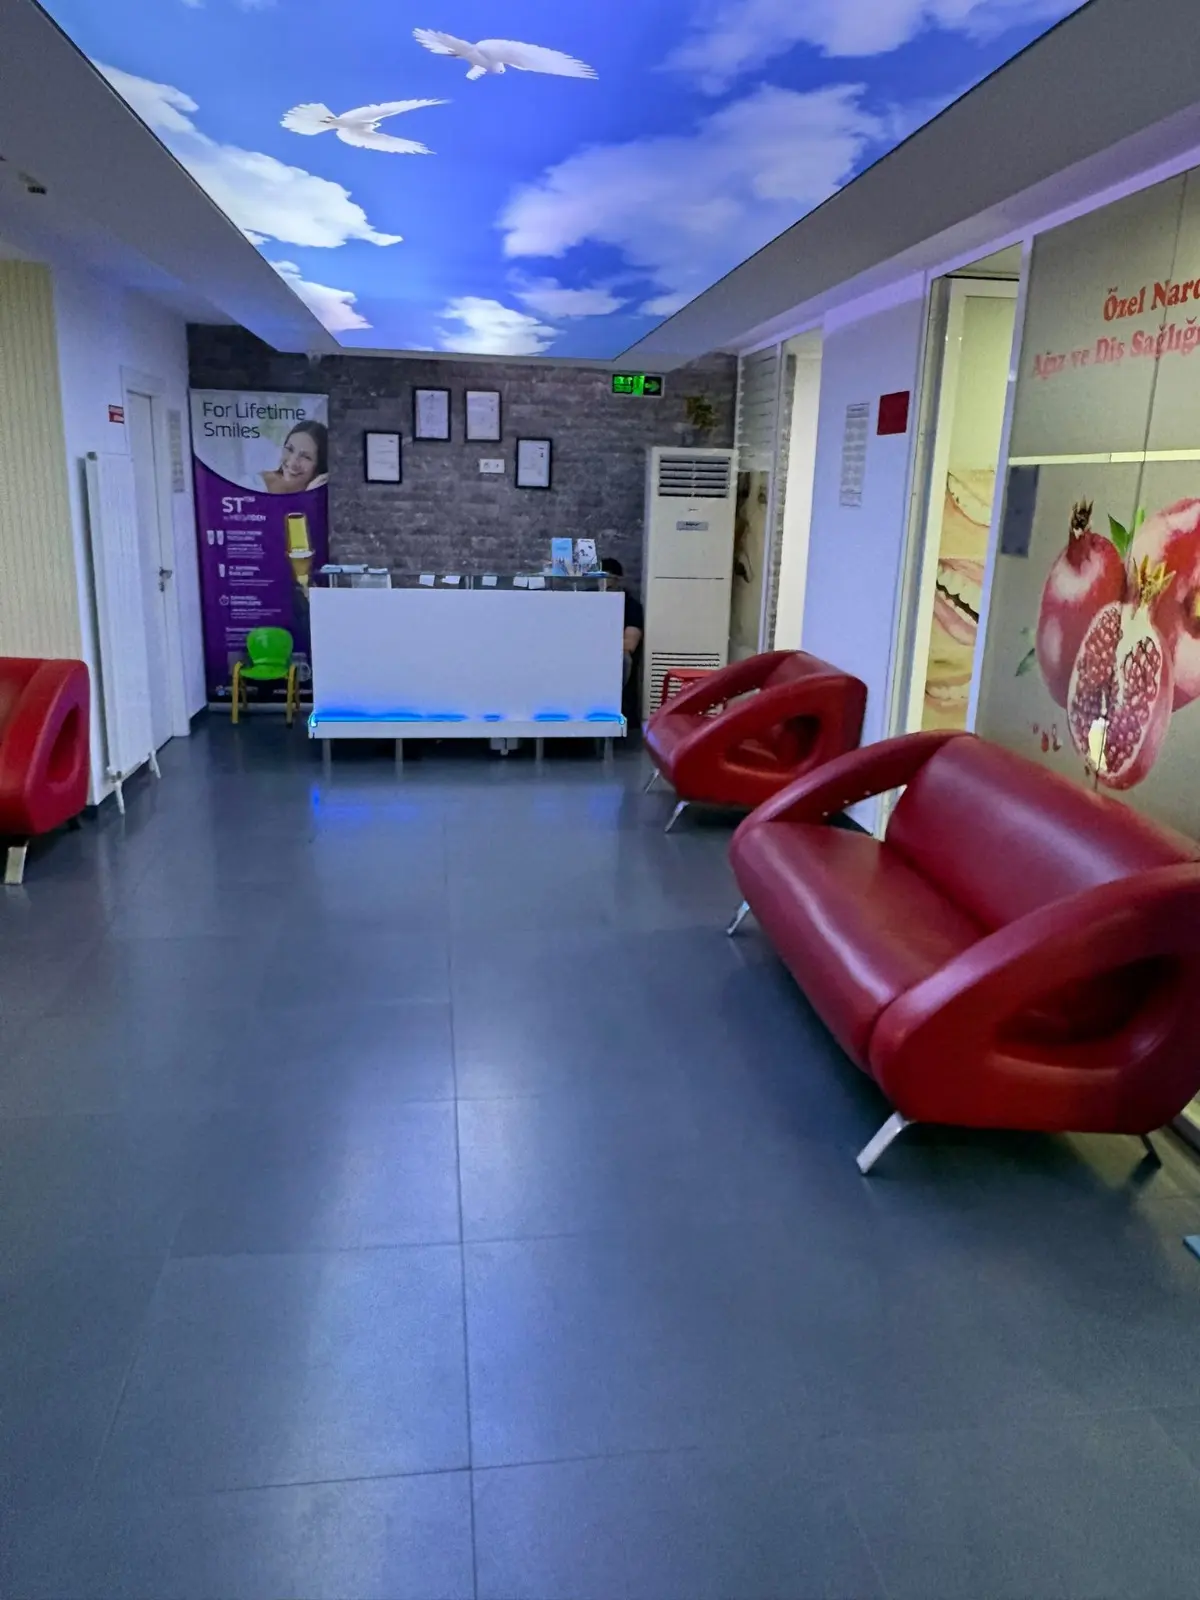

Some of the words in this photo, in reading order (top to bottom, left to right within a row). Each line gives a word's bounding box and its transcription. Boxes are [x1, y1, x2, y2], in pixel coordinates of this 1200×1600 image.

[1103, 286, 1146, 321] Özel
[203, 402, 232, 418] For
[235, 402, 306, 421] Lifetime
[204, 422, 261, 439] Smiles
